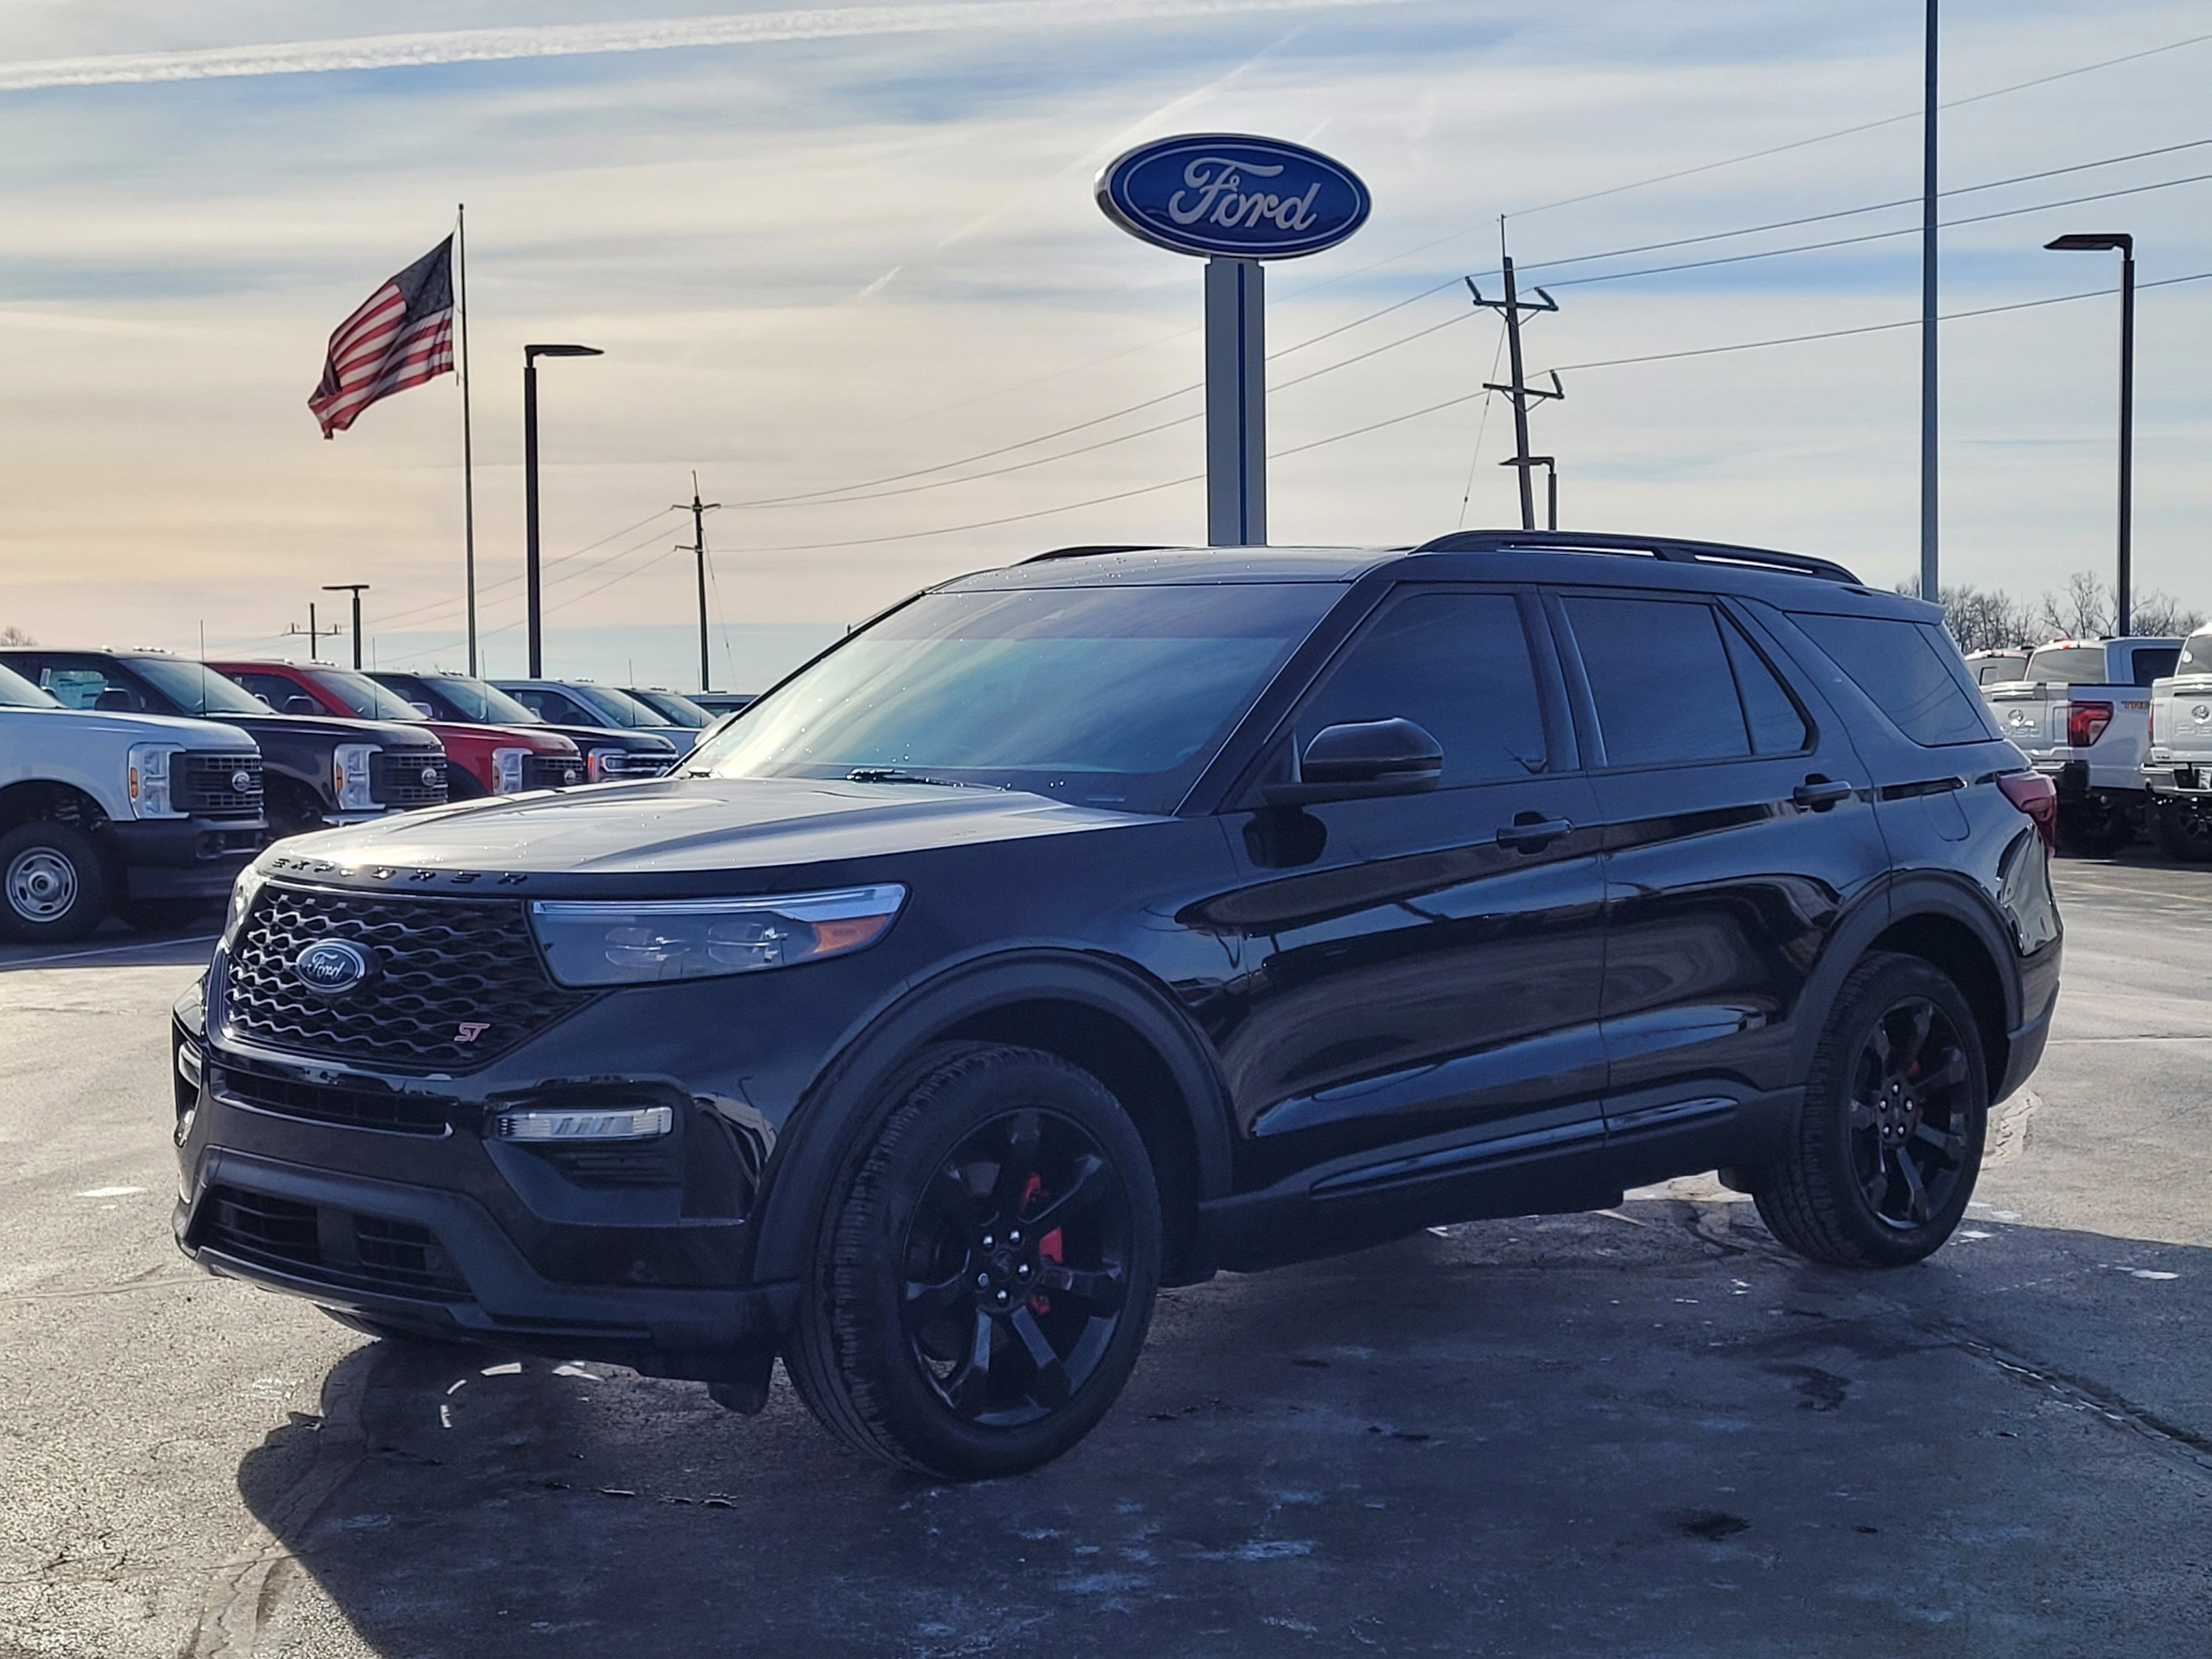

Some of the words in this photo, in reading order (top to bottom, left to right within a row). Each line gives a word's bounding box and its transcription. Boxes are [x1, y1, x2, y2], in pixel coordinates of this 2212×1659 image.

[1169, 157, 1321, 230] Ford
[307, 951, 346, 980] Ford
[454, 1022, 490, 1041] ST
